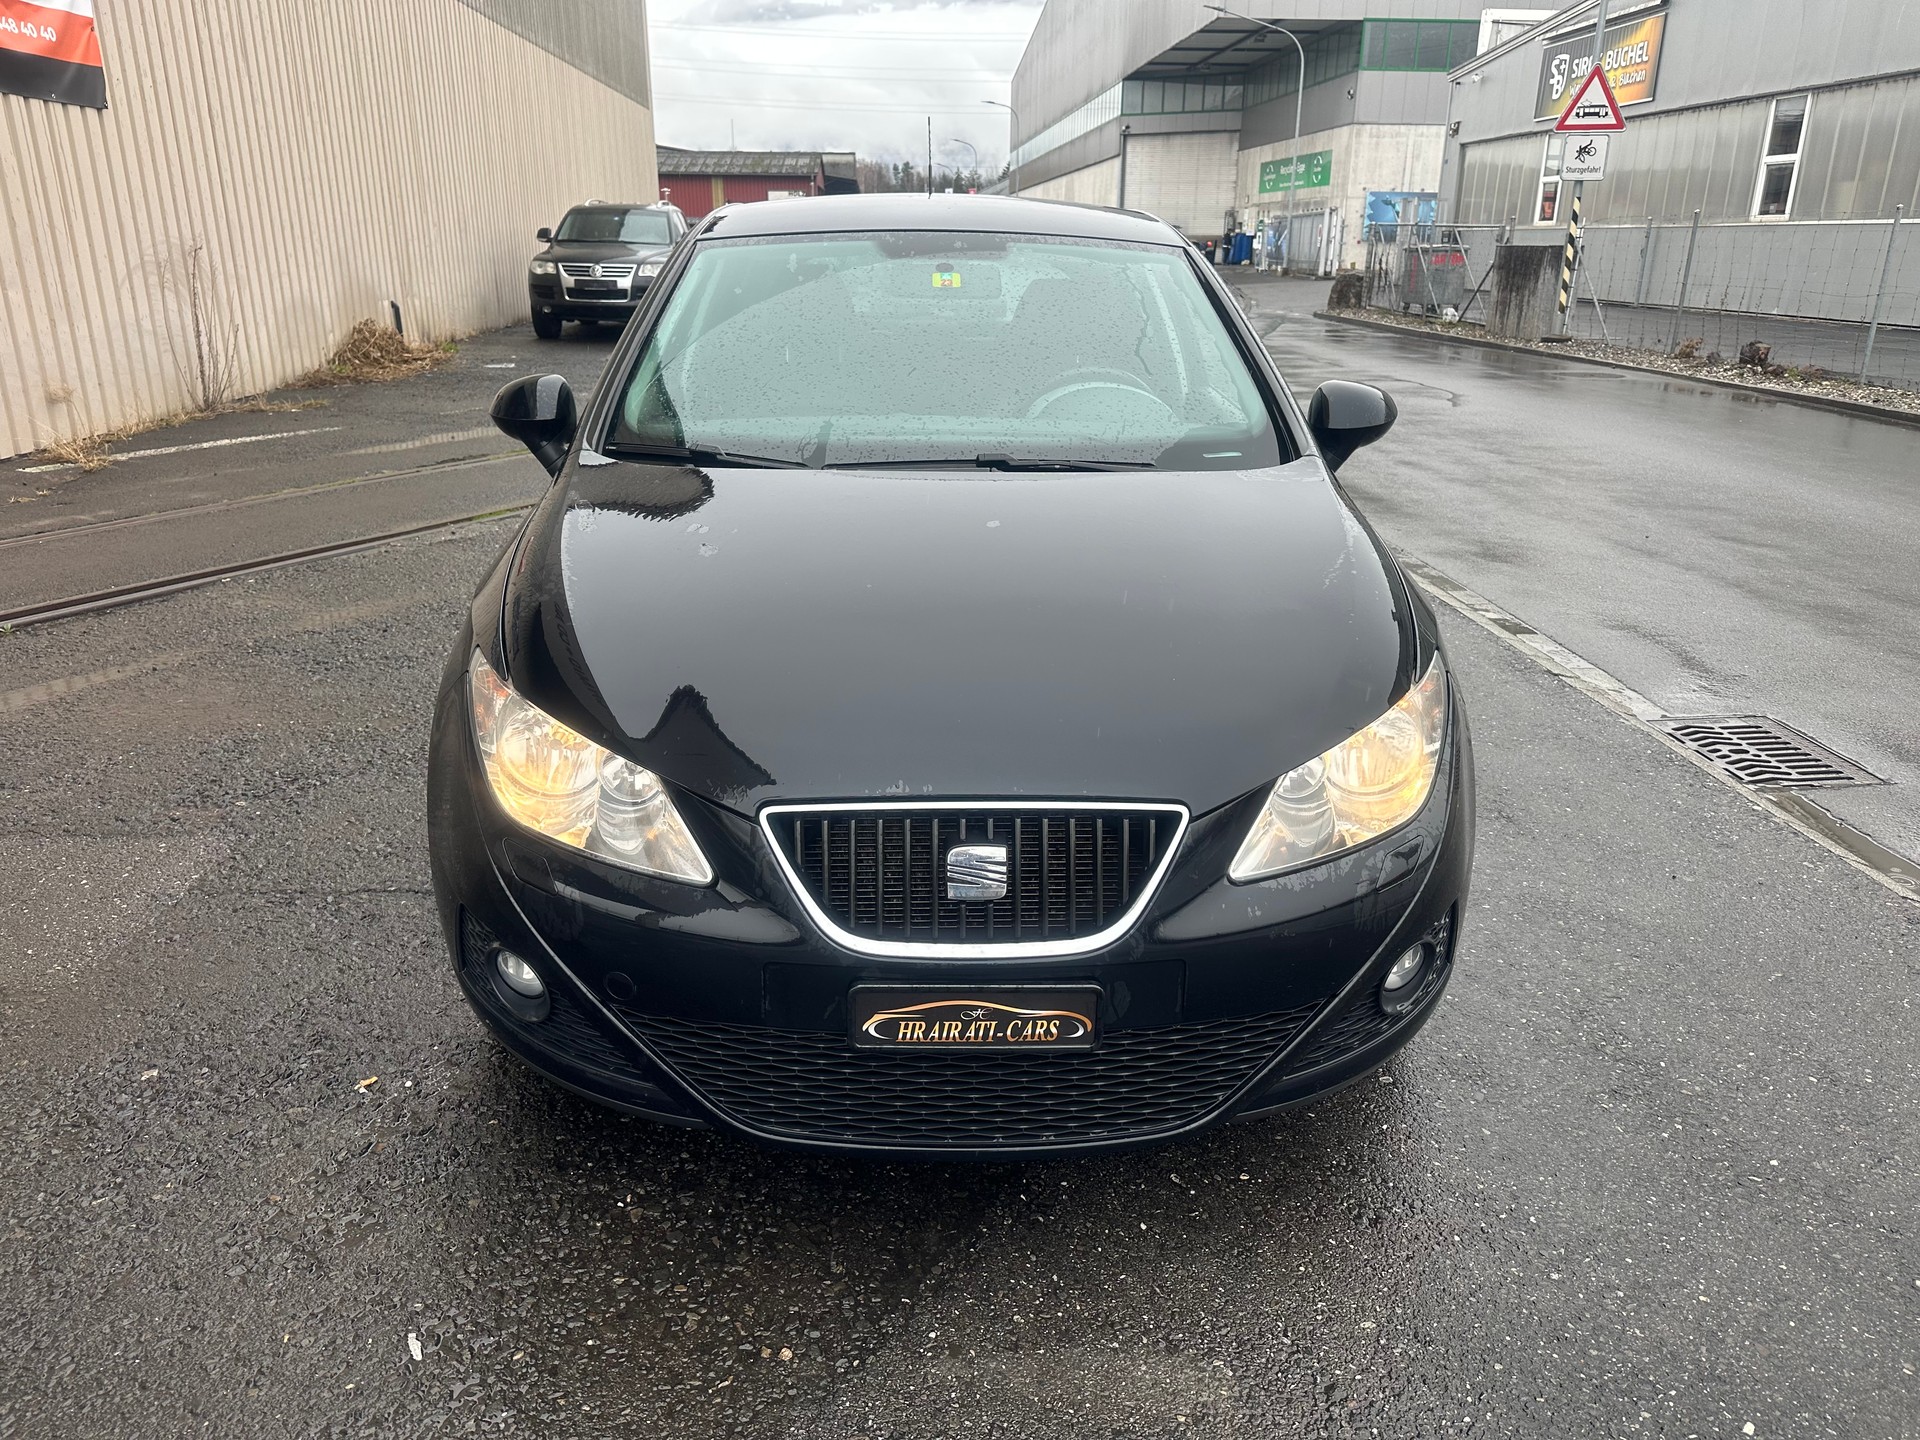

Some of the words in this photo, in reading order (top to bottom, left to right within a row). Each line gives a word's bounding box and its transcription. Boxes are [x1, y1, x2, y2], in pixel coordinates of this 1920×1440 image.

[20, 21, 38, 39] 40
[40, 25, 57, 42] 40
[1565, 165, 1602, 175] Sturzgefahr!
